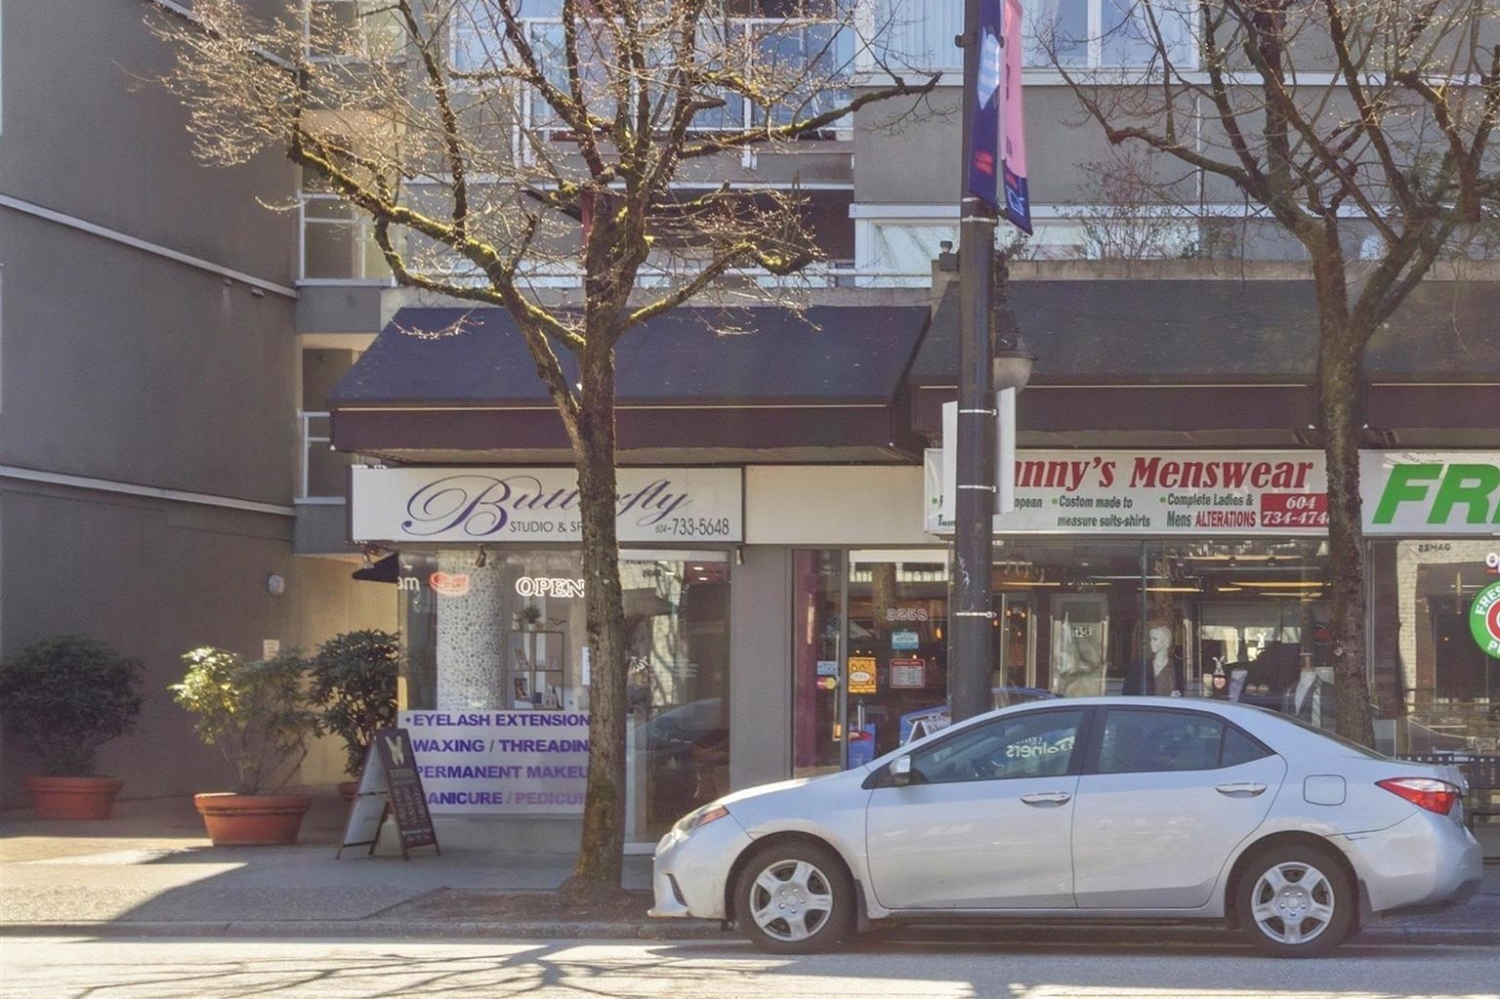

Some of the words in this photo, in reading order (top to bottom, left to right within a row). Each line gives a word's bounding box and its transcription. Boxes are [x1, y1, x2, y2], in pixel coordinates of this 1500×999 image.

[1129, 457, 1314, 489] Menswear
[402, 475, 692, 535] Buttfly
[1059, 495, 1093, 509] Custom
[1096, 495, 1121, 508] made
[1124, 496, 1133, 508] to
[1167, 493, 1211, 508] Complete
[1213, 492, 1244, 506] Ladies
[1286, 496, 1316, 509] 604
[1057, 516, 1098, 527] measure
[1166, 511, 1191, 527] Mens
[1195, 511, 1256, 527] ALTERATIONS
[1263, 511, 1330, 525] 734-474
[510, 521, 553, 533] STUDIO
[558, 522, 566, 533] &
[515, 577, 584, 598] OPEN
[413, 714, 490, 726] EYELASH
[413, 740, 485, 752] WAXING
[499, 740, 589, 752] THREADIN
[527, 766, 588, 779] MAKEU
[427, 792, 503, 805] ANICURE
